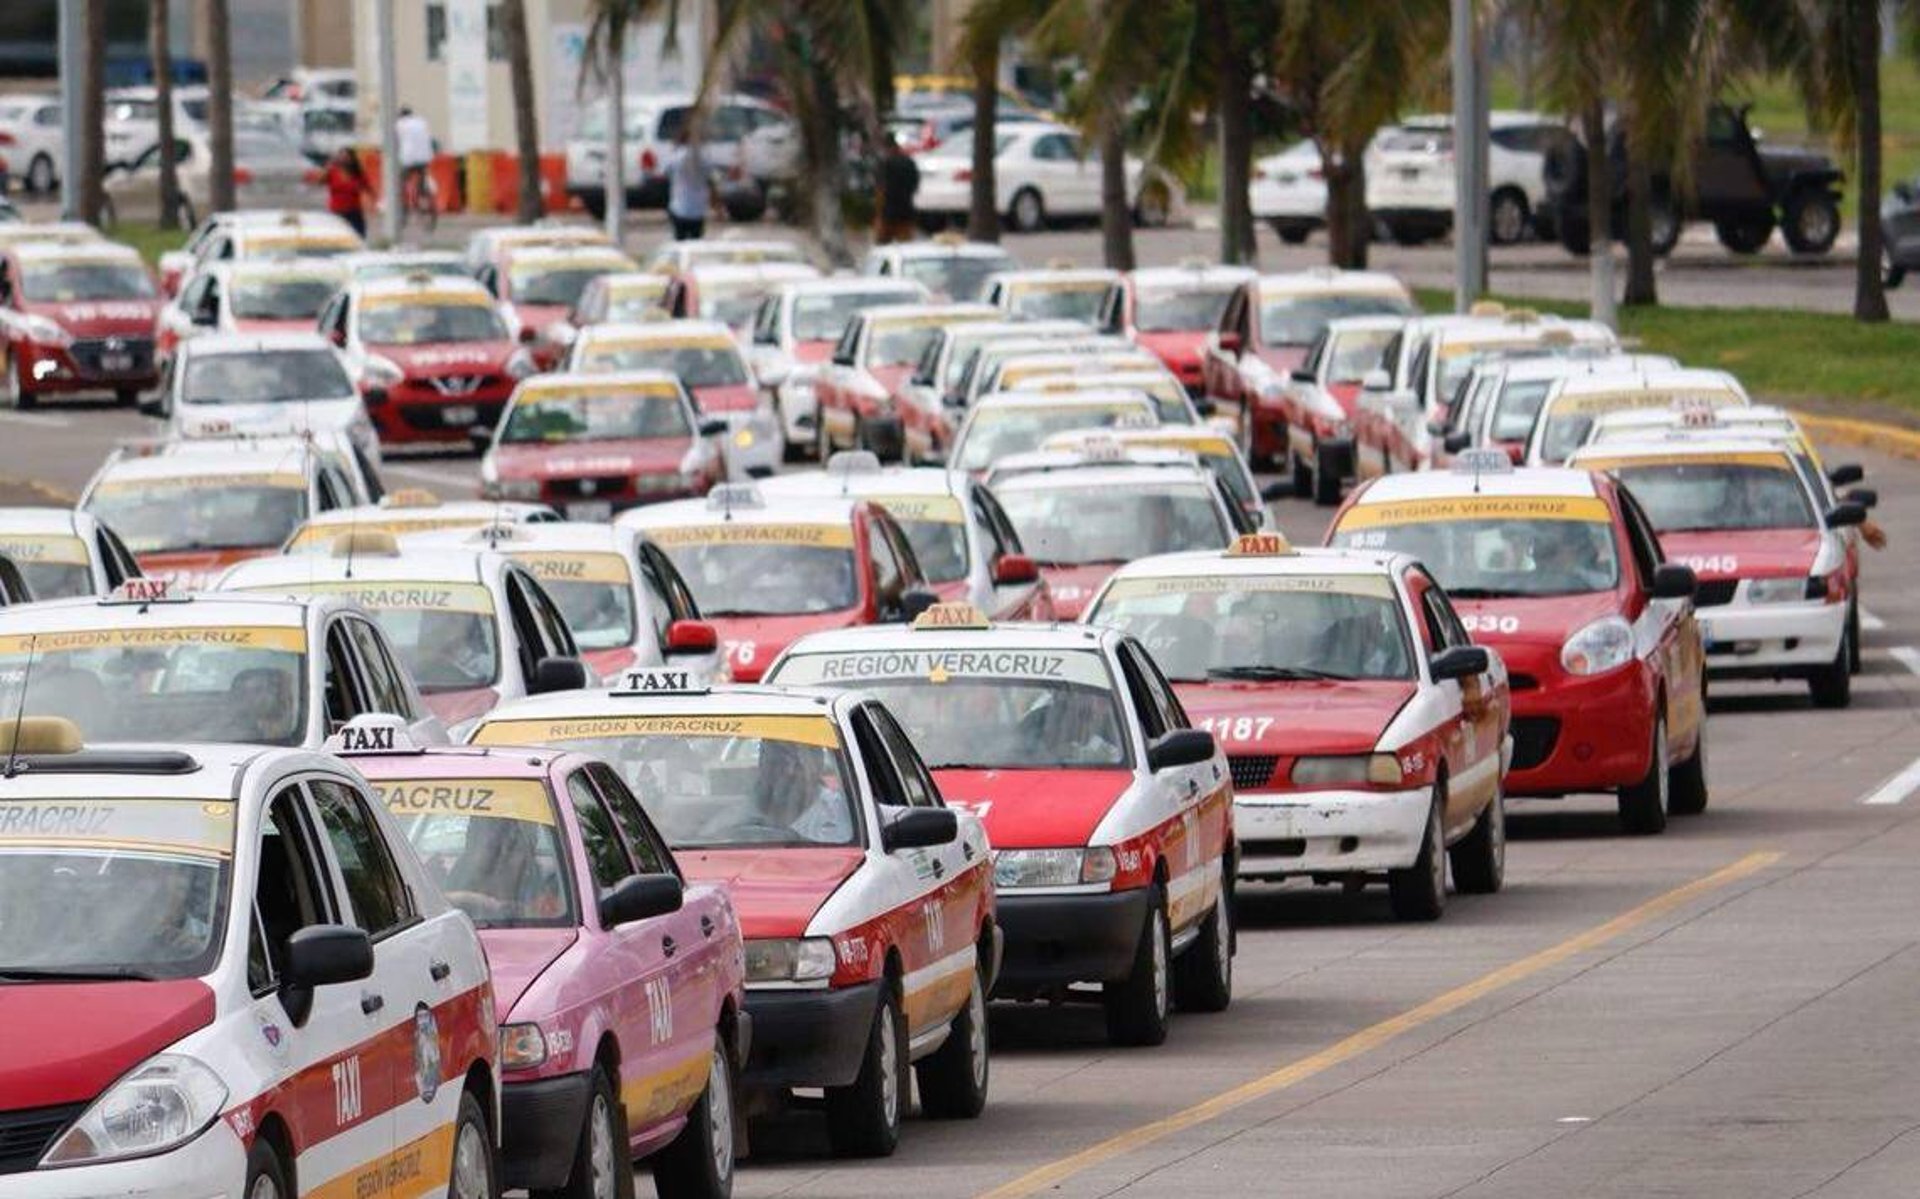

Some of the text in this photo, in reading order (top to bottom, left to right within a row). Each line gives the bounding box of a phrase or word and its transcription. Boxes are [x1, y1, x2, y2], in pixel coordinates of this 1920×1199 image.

[1460, 501, 1567, 515] VERACRUZ
[719, 526, 825, 541] VERACRUZ
[1239, 536, 1280, 554] TAXI
[125, 580, 168, 600] TAXI
[931, 606, 975, 625] TAXI
[121, 630, 253, 645] VERACRUZ
[927, 653, 1063, 677] VERACRUZ
[627, 672, 689, 690] TAXI
[635, 720, 743, 733] VERACRUZ
[341, 727, 395, 750] TAXI
[645, 976, 673, 1045] TAXI
[332, 1054, 362, 1127] TAXI
